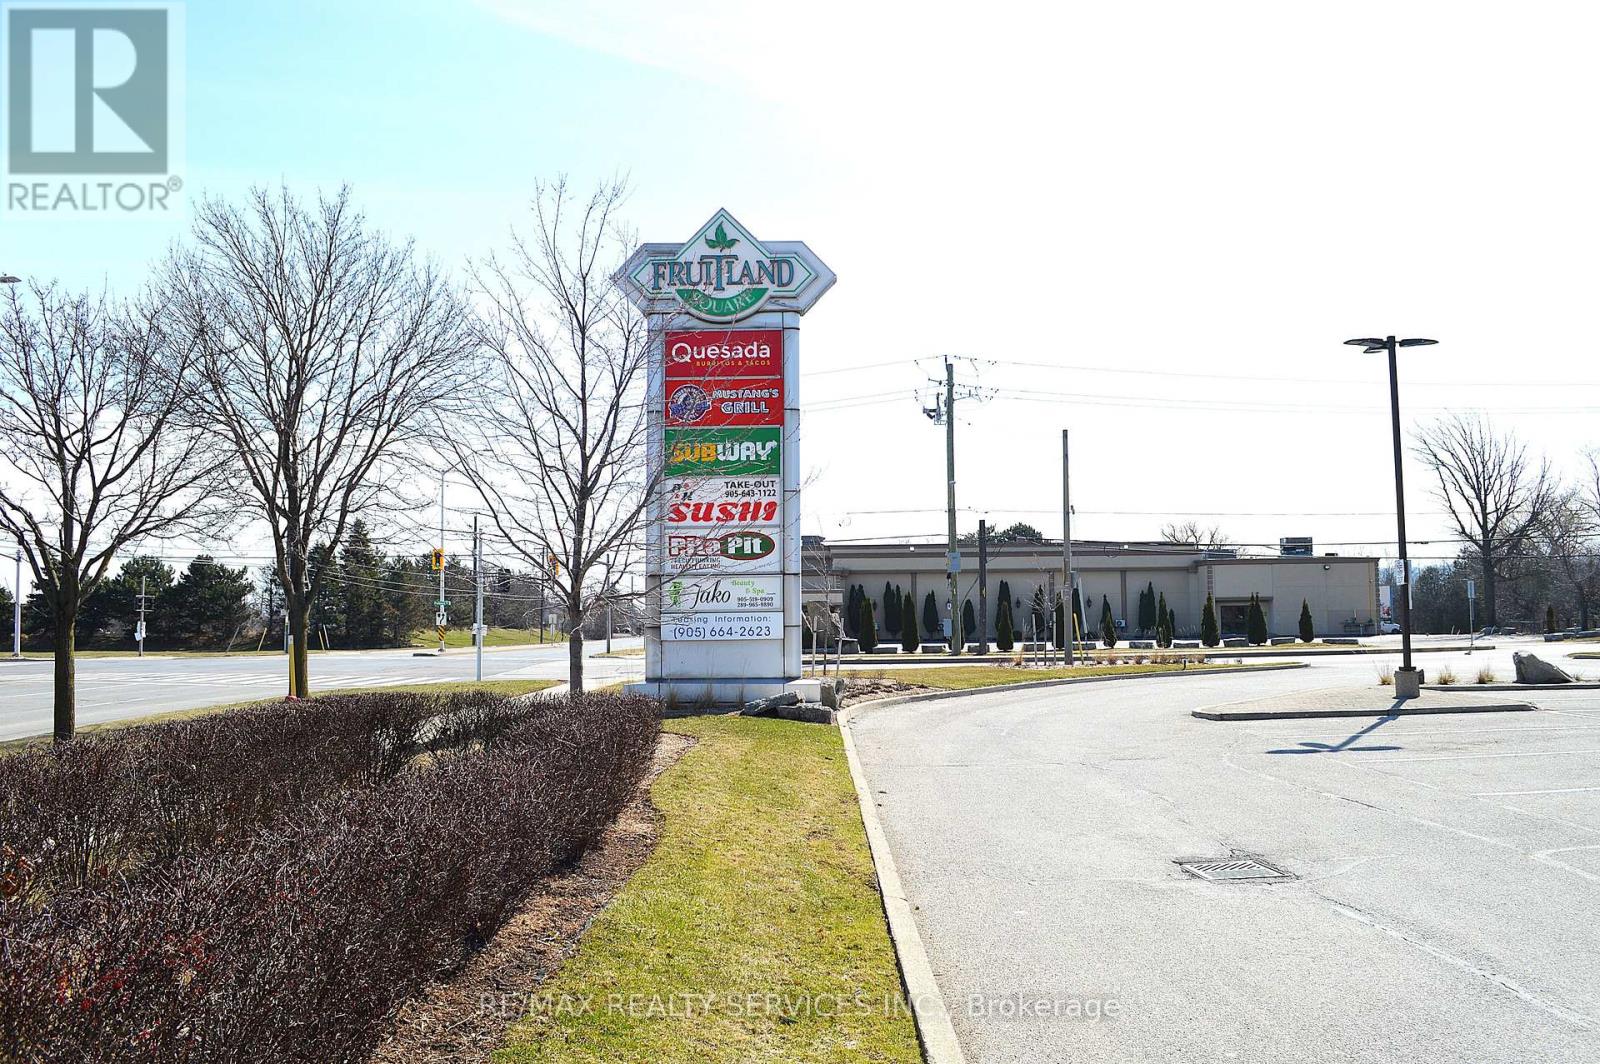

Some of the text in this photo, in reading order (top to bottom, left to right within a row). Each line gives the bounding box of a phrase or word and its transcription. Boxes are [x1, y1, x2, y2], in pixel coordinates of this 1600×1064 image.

[651, 255, 794, 291] FRUITLAND
[672, 342, 771, 363] Quesada
[712, 389, 779, 399] MUSTANG'S
[720, 401, 770, 414] GRILL
[671, 440, 778, 463] SUBWAY
[724, 480, 776, 489] TAKE-OUT
[724, 489, 777, 498] 905-643-1122
[668, 501, 778, 522] SUSHI
[727, 537, 762, 554] Pit
[673, 626, 771, 639] (905) 664-2623
